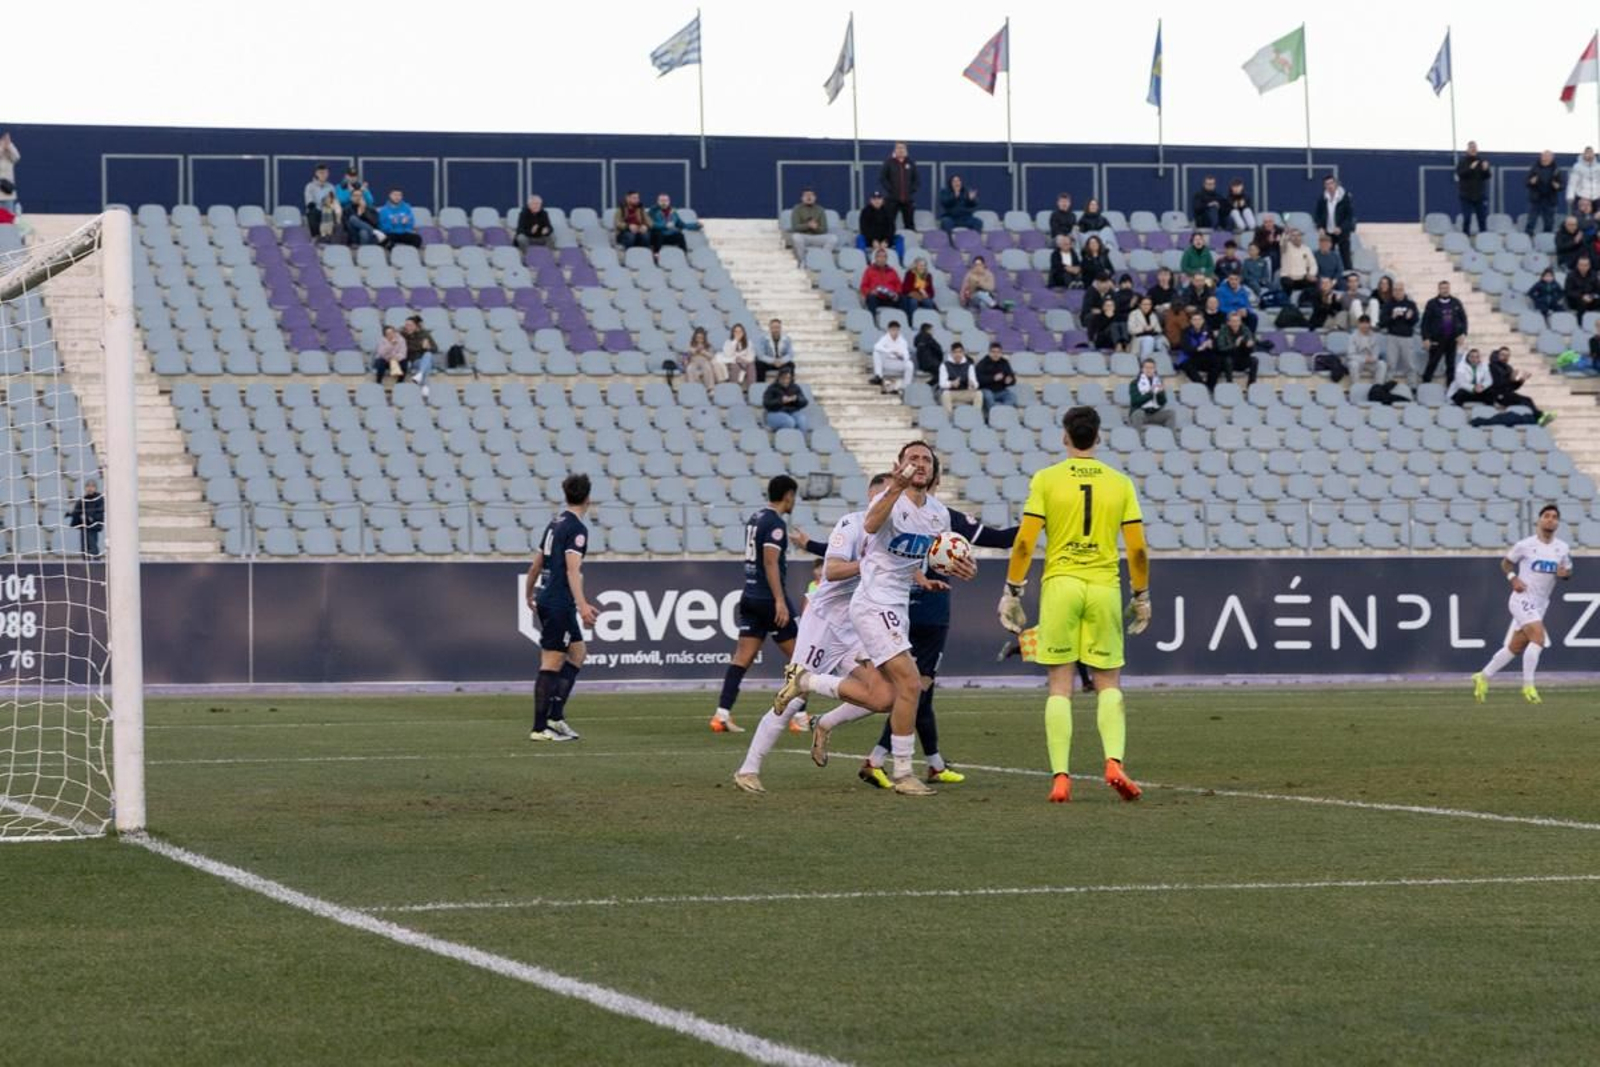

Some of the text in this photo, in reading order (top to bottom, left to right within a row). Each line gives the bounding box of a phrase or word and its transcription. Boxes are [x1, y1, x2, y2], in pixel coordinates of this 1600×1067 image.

[1079, 484, 1092, 536] 1
[879, 610, 901, 630] 19
[608, 653, 619, 668] y
[620, 650, 664, 666] móvil,
[665, 650, 695, 664] más
[695, 653, 731, 664] cerca
[805, 645, 825, 669] 18
